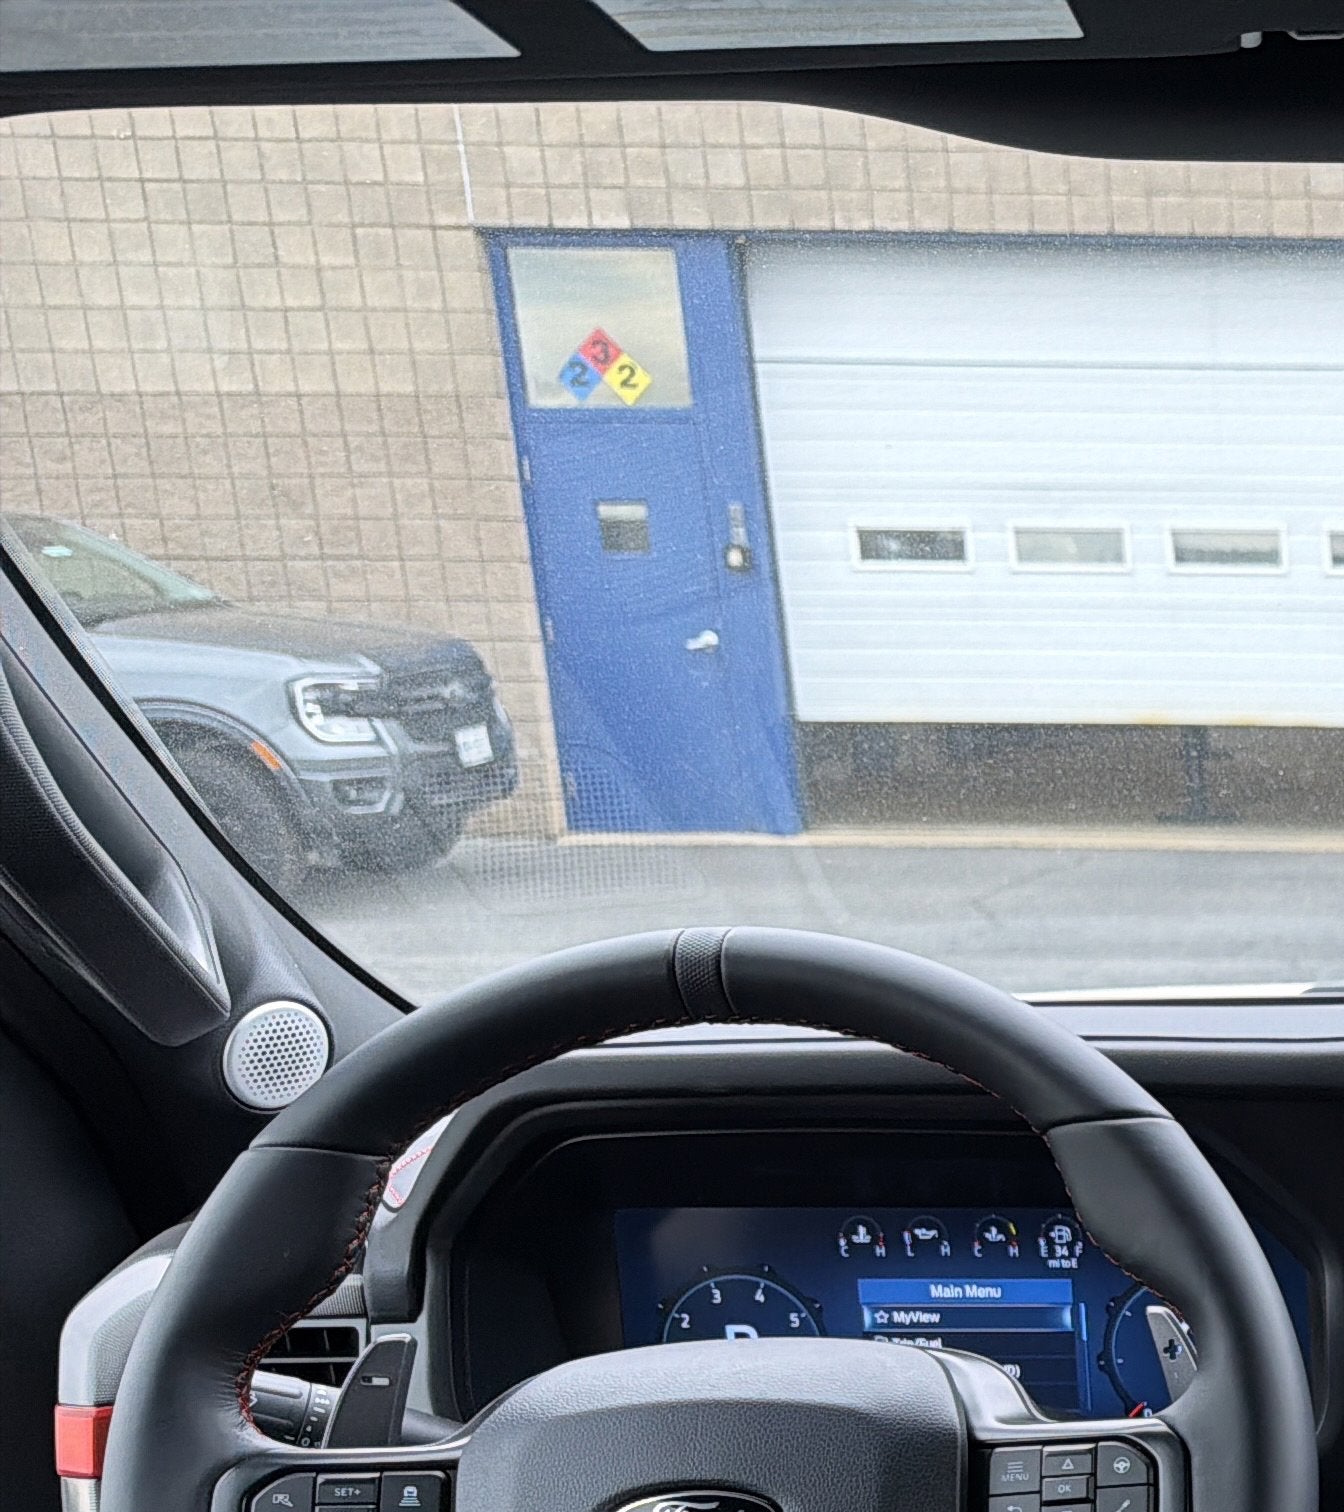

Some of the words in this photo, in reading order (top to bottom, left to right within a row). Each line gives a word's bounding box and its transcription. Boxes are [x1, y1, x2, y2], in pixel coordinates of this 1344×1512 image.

[592, 340, 610, 364] 3
[568, 361, 590, 387] 2
[618, 364, 639, 388] 2
[875, 1244, 886, 1258] H
[1009, 1245, 1019, 1258] H
[1040, 1245, 1049, 1258] E
[1054, 1245, 1069, 1257] 34
[712, 1289, 721, 1304] 3
[755, 1289, 765, 1303] 4
[929, 1284, 963, 1299] Main
[965, 1284, 1002, 1299] Menu
[680, 1313, 690, 1329] 2
[789, 1312, 800, 1328] 5
[892, 1310, 941, 1326] MyView
[1001, 1473, 1029, 1482] MENU
[334, 1487, 361, 1497] SET+
[1058, 1485, 1072, 1493] OK
